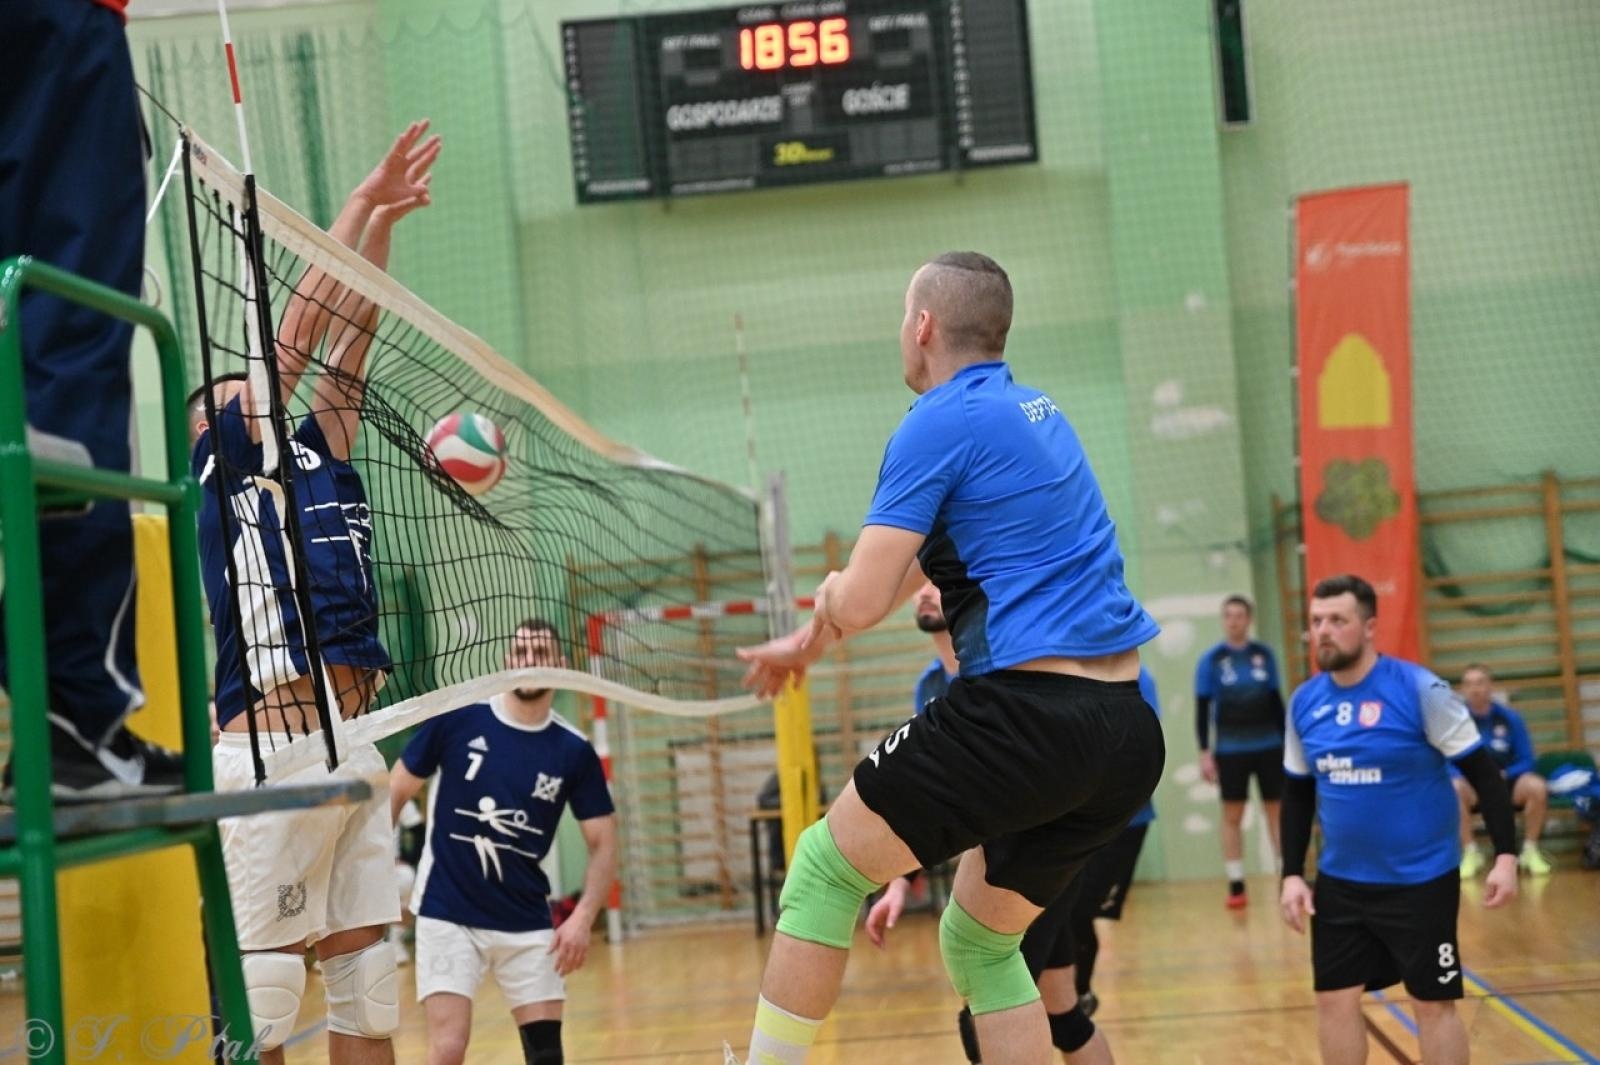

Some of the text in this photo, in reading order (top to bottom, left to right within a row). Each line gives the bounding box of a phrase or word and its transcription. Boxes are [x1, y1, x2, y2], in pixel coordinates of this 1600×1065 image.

[1335, 701, 1353, 726] 8
[884, 722, 911, 755] 5
[1438, 942, 1455, 968] 8
